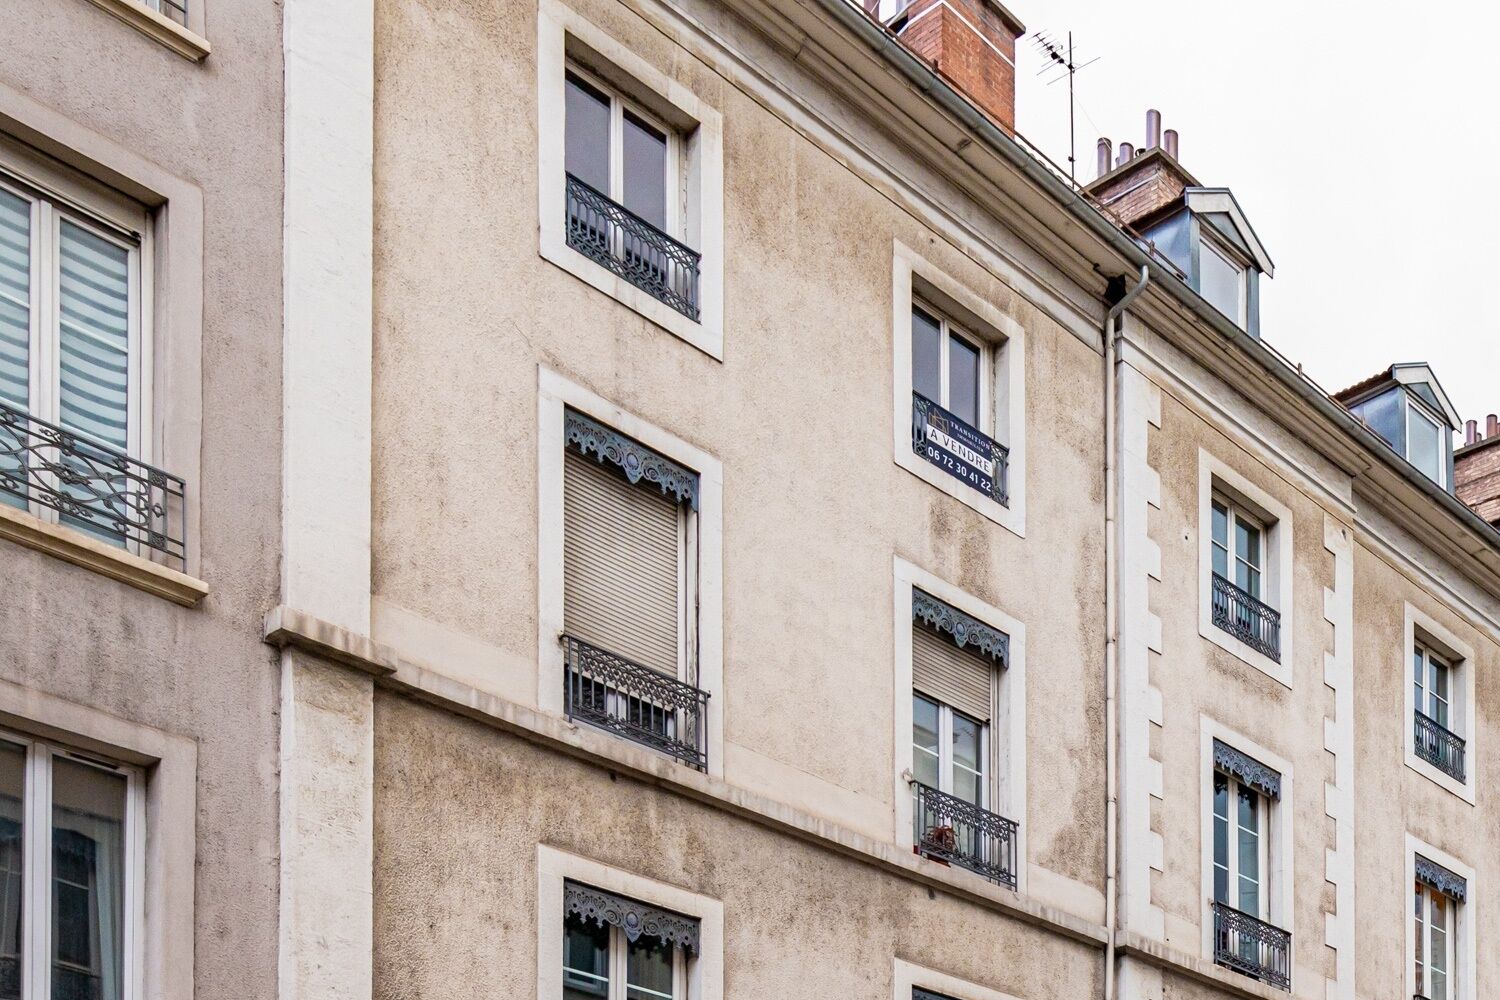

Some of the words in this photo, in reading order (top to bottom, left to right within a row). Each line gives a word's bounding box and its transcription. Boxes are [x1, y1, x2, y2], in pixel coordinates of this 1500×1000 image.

[930, 428, 938, 441] A
[942, 434, 989, 473] VENDRE
[950, 420, 990, 450] TRANSITION
[928, 446, 940, 460] 06
[942, 454, 954, 469] 72
[956, 462, 967, 476] 30
[969, 472, 978, 484] 41
[980, 478, 992, 492] 22
